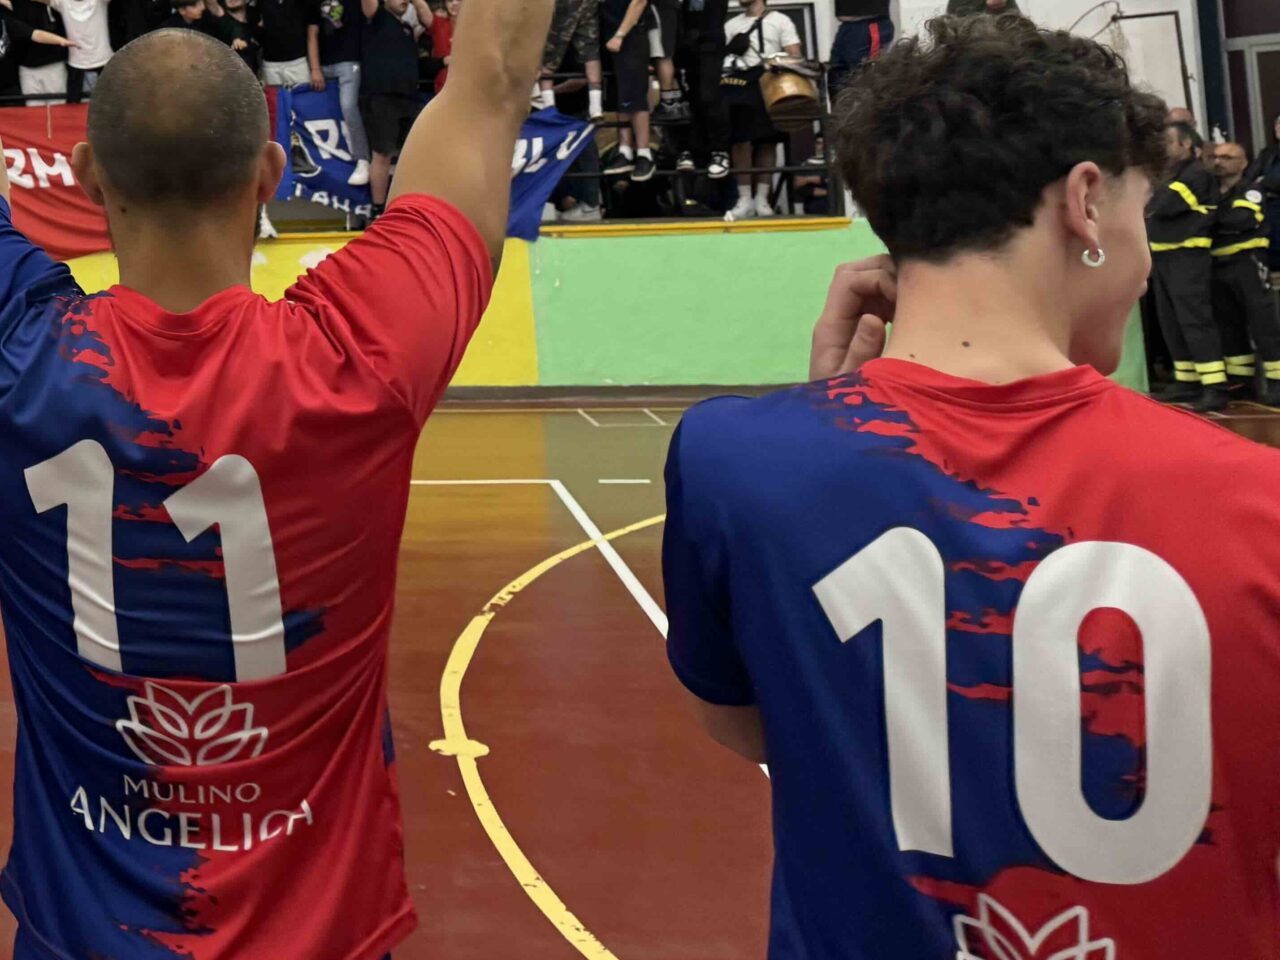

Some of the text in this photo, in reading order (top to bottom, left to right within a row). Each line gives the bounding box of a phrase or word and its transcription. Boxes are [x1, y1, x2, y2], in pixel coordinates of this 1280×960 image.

[24, 439, 287, 682] 11
[812, 526, 1213, 885] 10
[70, 785, 314, 852] ANGELICA
[123, 774, 261, 804] MULINO
